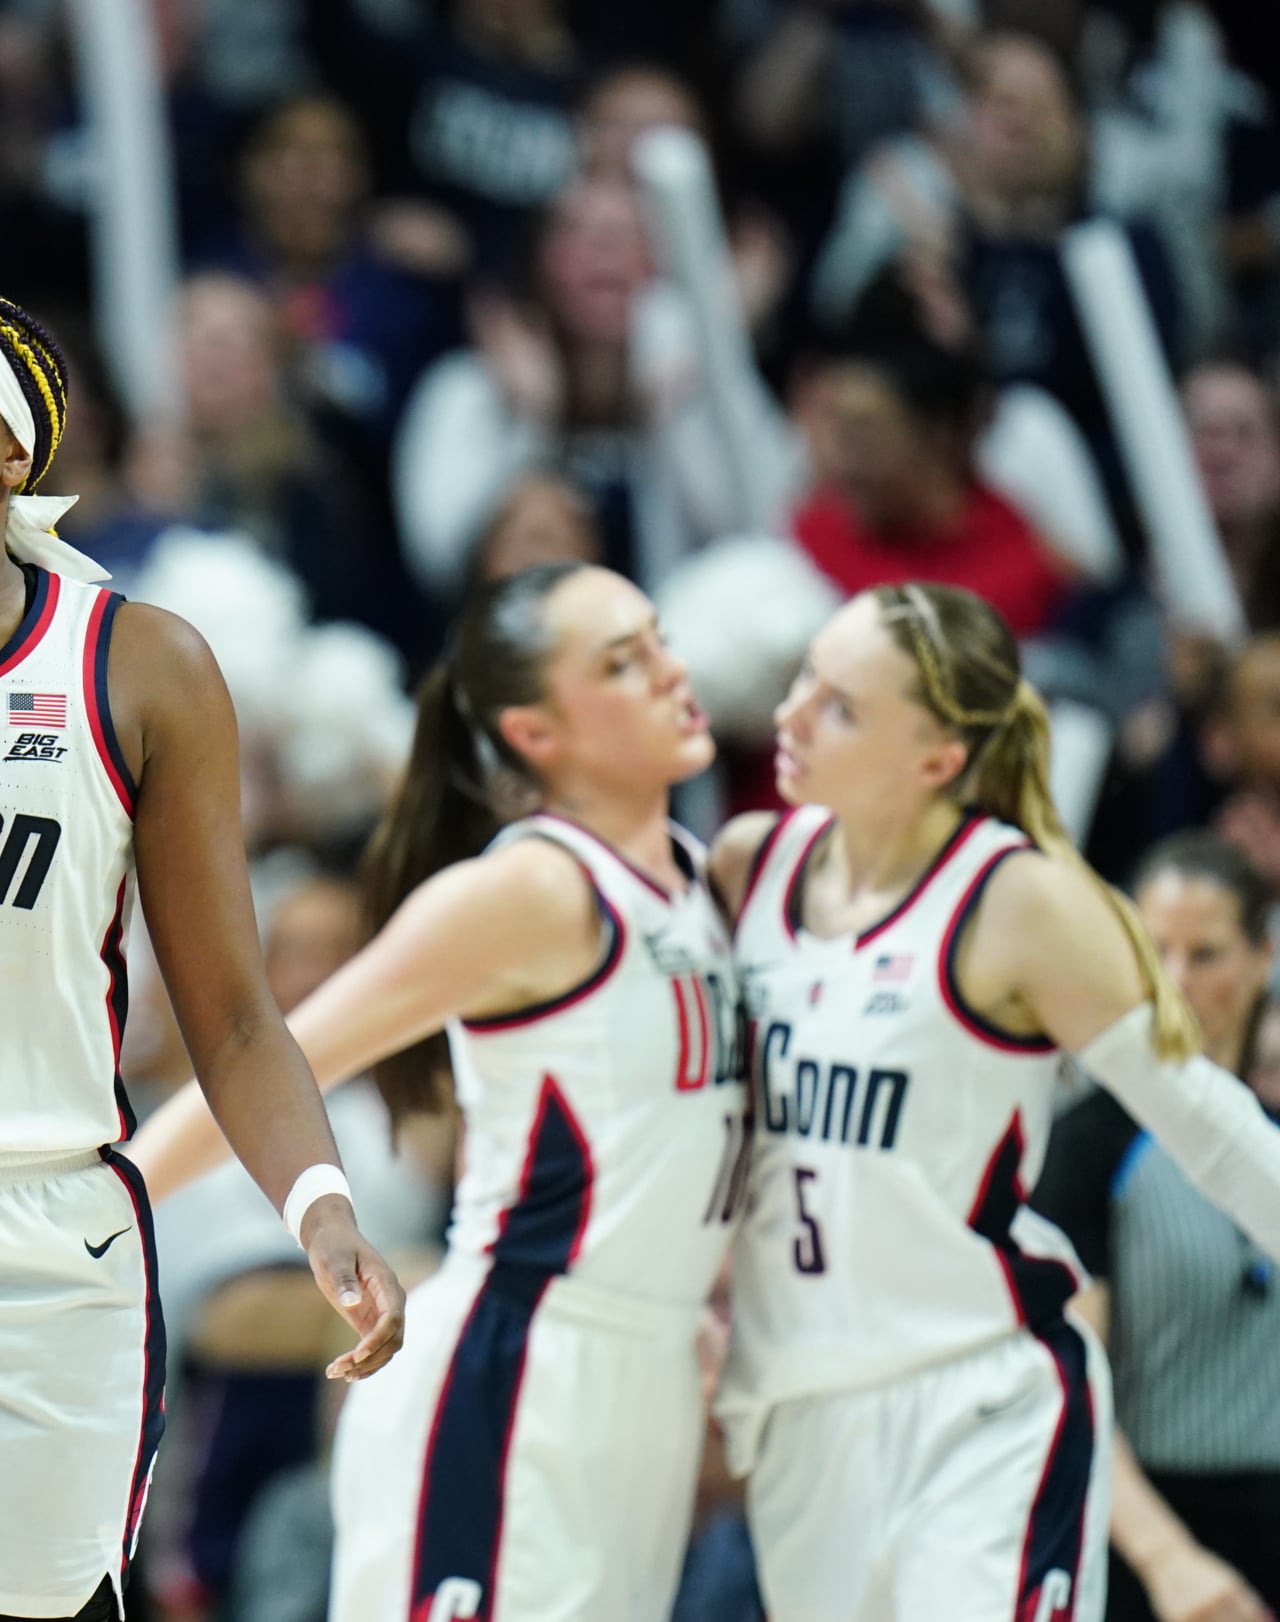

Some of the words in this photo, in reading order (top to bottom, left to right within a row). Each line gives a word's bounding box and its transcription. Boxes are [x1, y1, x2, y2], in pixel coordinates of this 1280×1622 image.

[8, 745, 68, 758] EAST
[15, 733, 59, 746] BIG
[751, 1021, 910, 1153] Conn
[795, 1167, 827, 1276] 5
